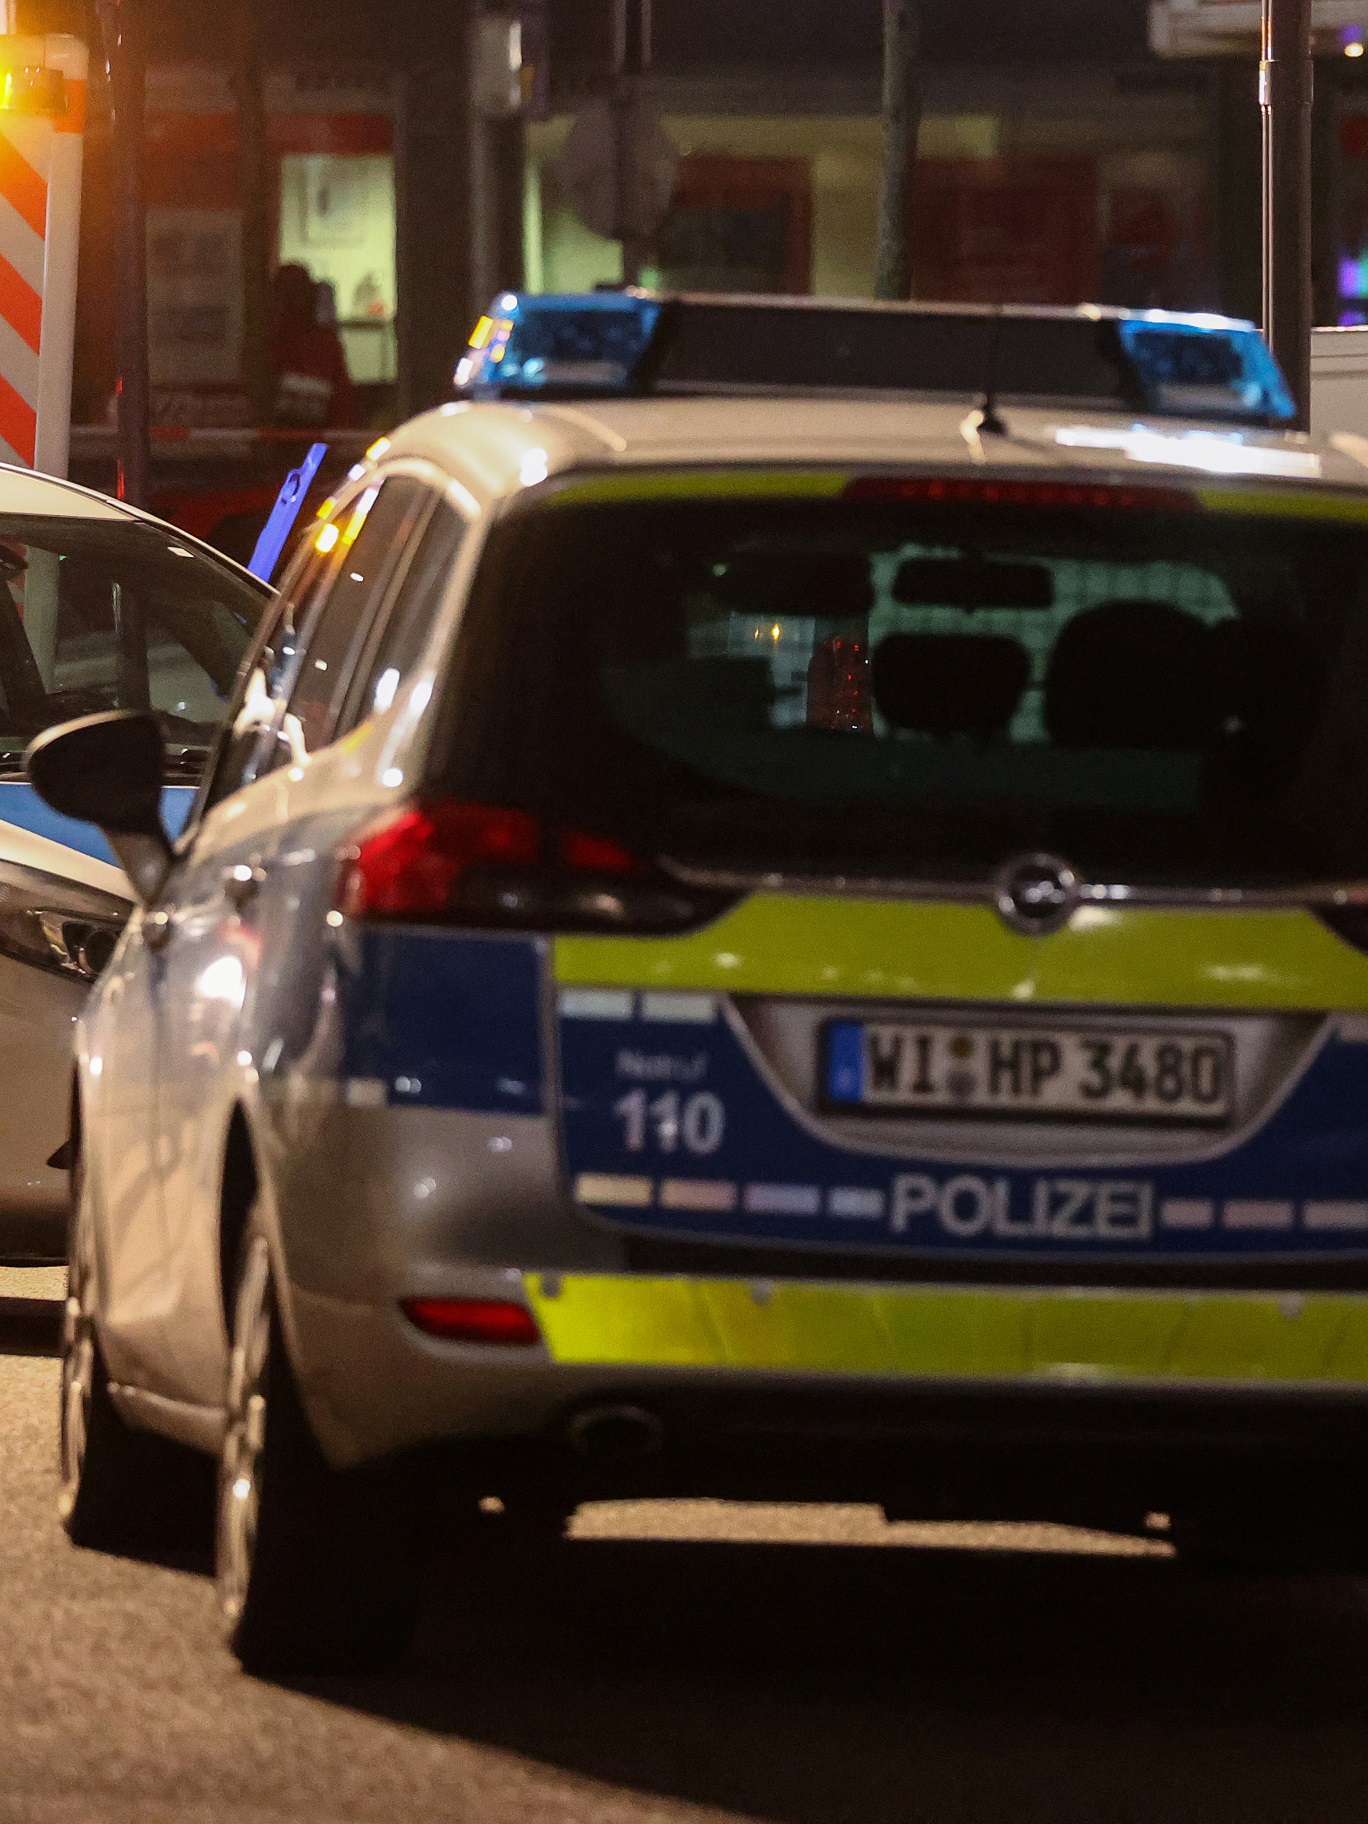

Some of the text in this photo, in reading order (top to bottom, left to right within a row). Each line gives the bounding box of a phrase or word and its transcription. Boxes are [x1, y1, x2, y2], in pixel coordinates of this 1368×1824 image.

[868, 1034, 1221, 1104] WI HP 3480
[613, 1088, 724, 1156] 110
[890, 1173, 1154, 1240] POLIZEI
